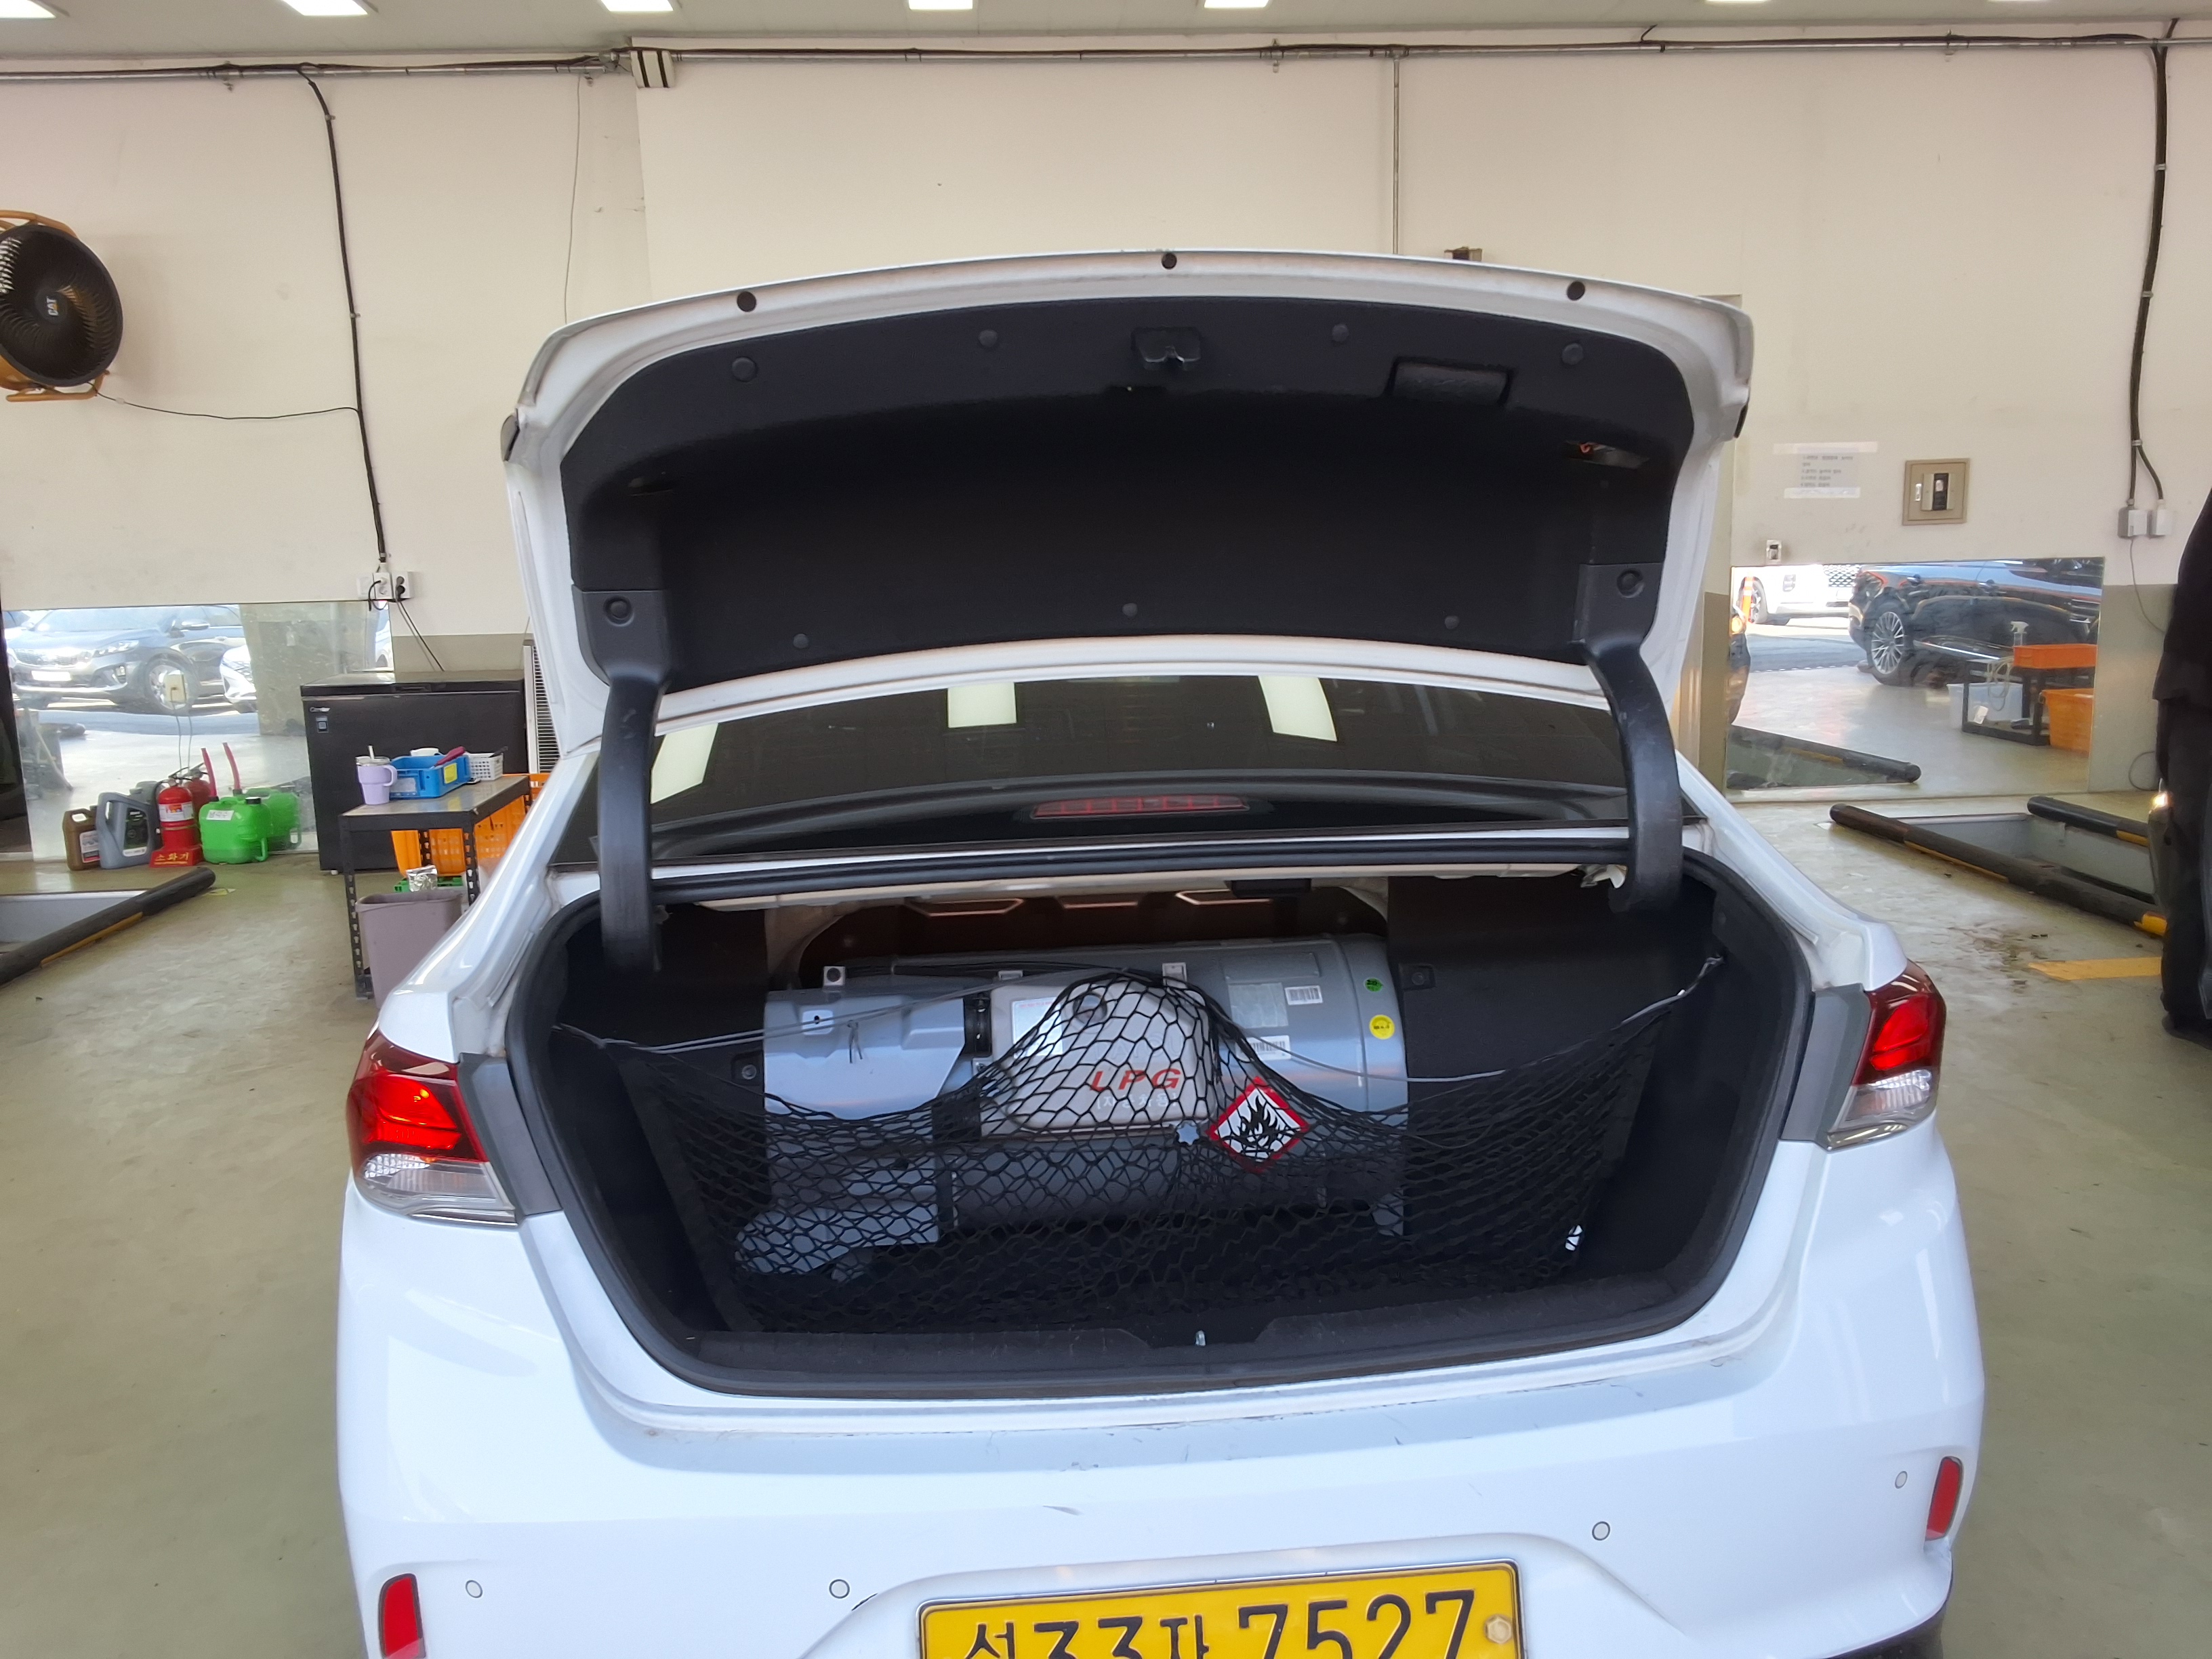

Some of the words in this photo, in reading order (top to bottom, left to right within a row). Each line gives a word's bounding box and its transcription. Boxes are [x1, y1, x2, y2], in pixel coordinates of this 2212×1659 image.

[46, 296, 59, 316] CAT
[155, 852, 189, 861] 소화기
[1090, 1068, 1181, 1092] LPG
[1237, 1589, 1475, 1659] 7527
